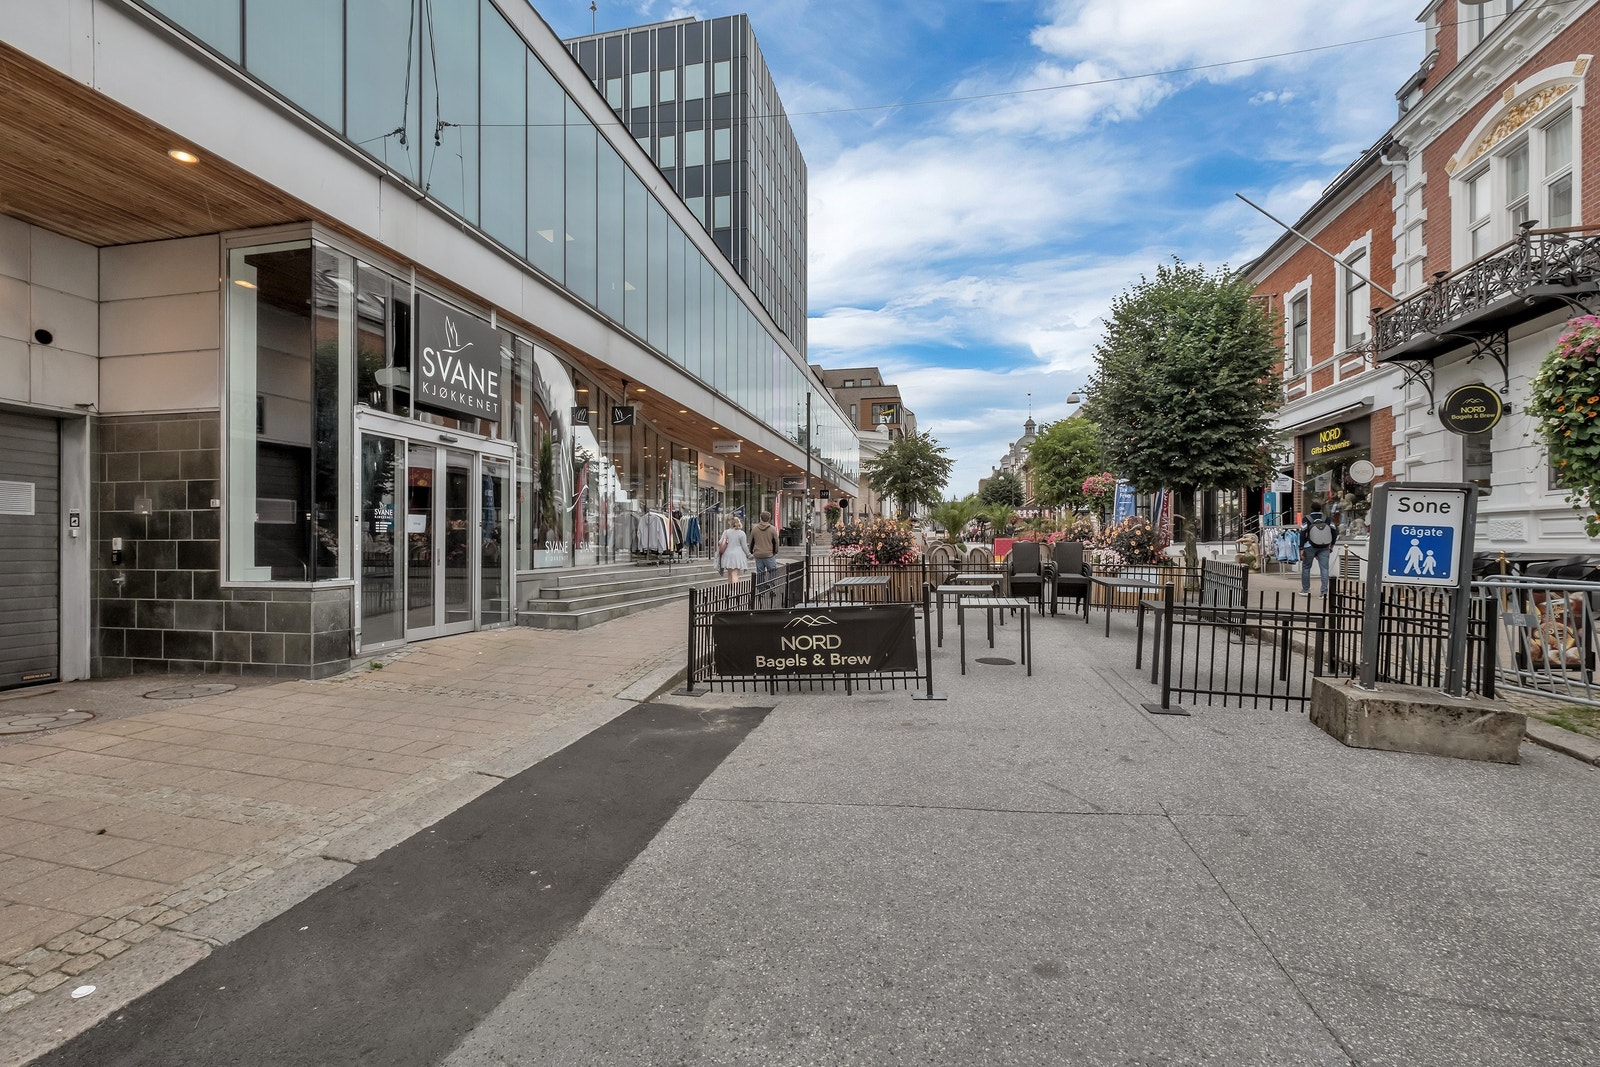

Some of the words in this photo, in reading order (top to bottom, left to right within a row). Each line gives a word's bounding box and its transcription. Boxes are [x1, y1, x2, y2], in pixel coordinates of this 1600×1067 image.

[422, 347, 498, 398] SVANE
[422, 381, 498, 413] KJØKKENET
[1461, 406, 1487, 414] NORD
[880, 416, 892, 424] EY
[1319, 427, 1341, 443] NORD
[1311, 446, 1323, 455] Gifts
[1327, 440, 1351, 452] Souvenirs
[1398, 497, 1451, 514] Sone
[1401, 526, 1444, 538] Gågate
[545, 541, 568, 554] SVANE
[781, 634, 842, 651] NORD
[755, 654, 807, 670] Bagels
[813, 653, 825, 666] &
[830, 653, 872, 666] Brew
